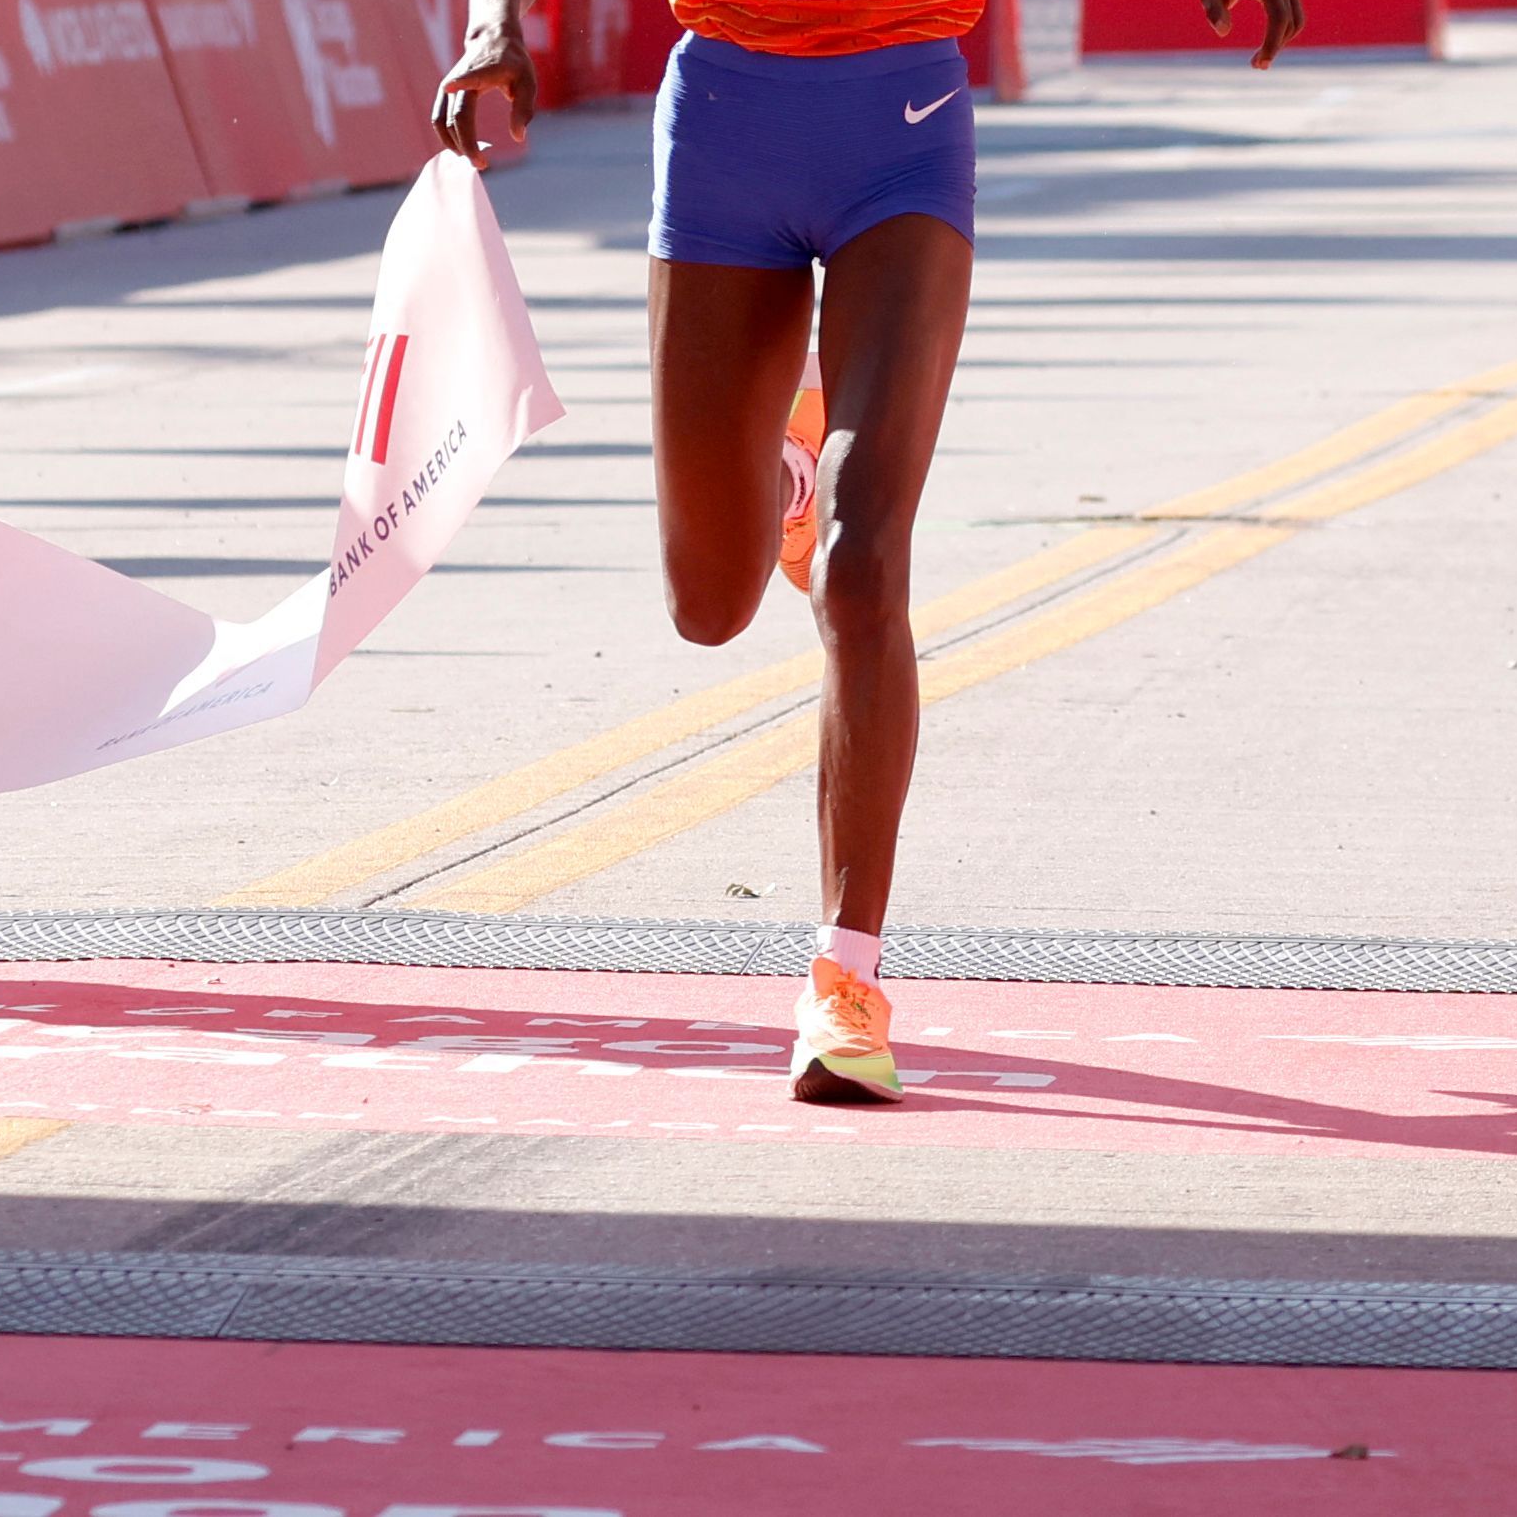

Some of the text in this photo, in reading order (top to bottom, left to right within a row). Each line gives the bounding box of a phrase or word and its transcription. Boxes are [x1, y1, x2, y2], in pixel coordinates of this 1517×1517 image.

[328, 418, 469, 598] BANK OF AMERICA
[121, 1006, 344, 1020] OF
[385, 1013, 1199, 1045] AMEICA
